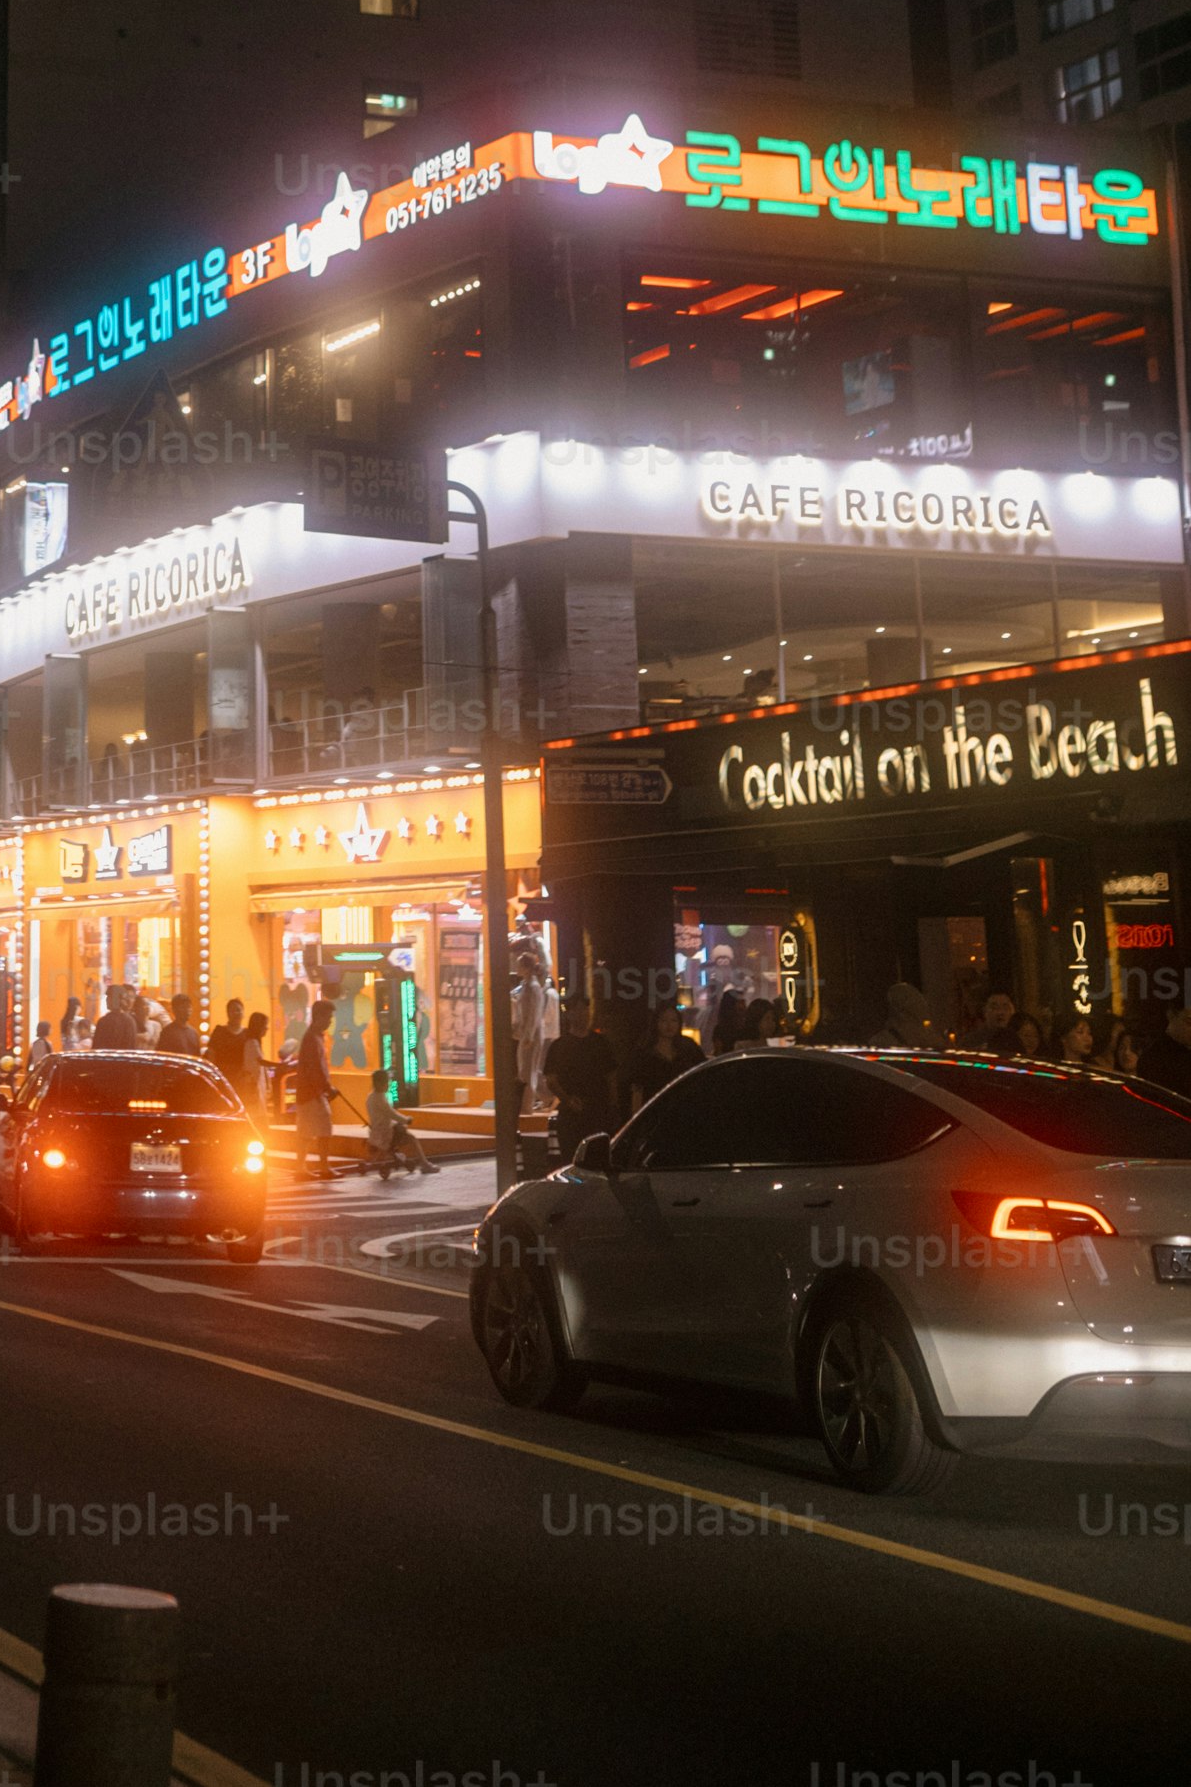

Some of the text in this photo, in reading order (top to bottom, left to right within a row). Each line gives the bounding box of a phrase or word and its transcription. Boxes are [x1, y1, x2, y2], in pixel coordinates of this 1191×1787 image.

[386, 162, 502, 233] 051-761-1235
[412, 141, 471, 187] 예약문의
[685, 129, 1149, 245] 로그인노래타운
[241, 241, 271, 286] 3F
[49, 246, 228, 397] 로그인노래타운
[352, 504, 424, 526] PARKING
[703, 479, 1052, 535] CAFE RICORICA
[65, 536, 251, 638] CAFE RICORICA
[718, 677, 1177, 811] Cocktail on the Beach
